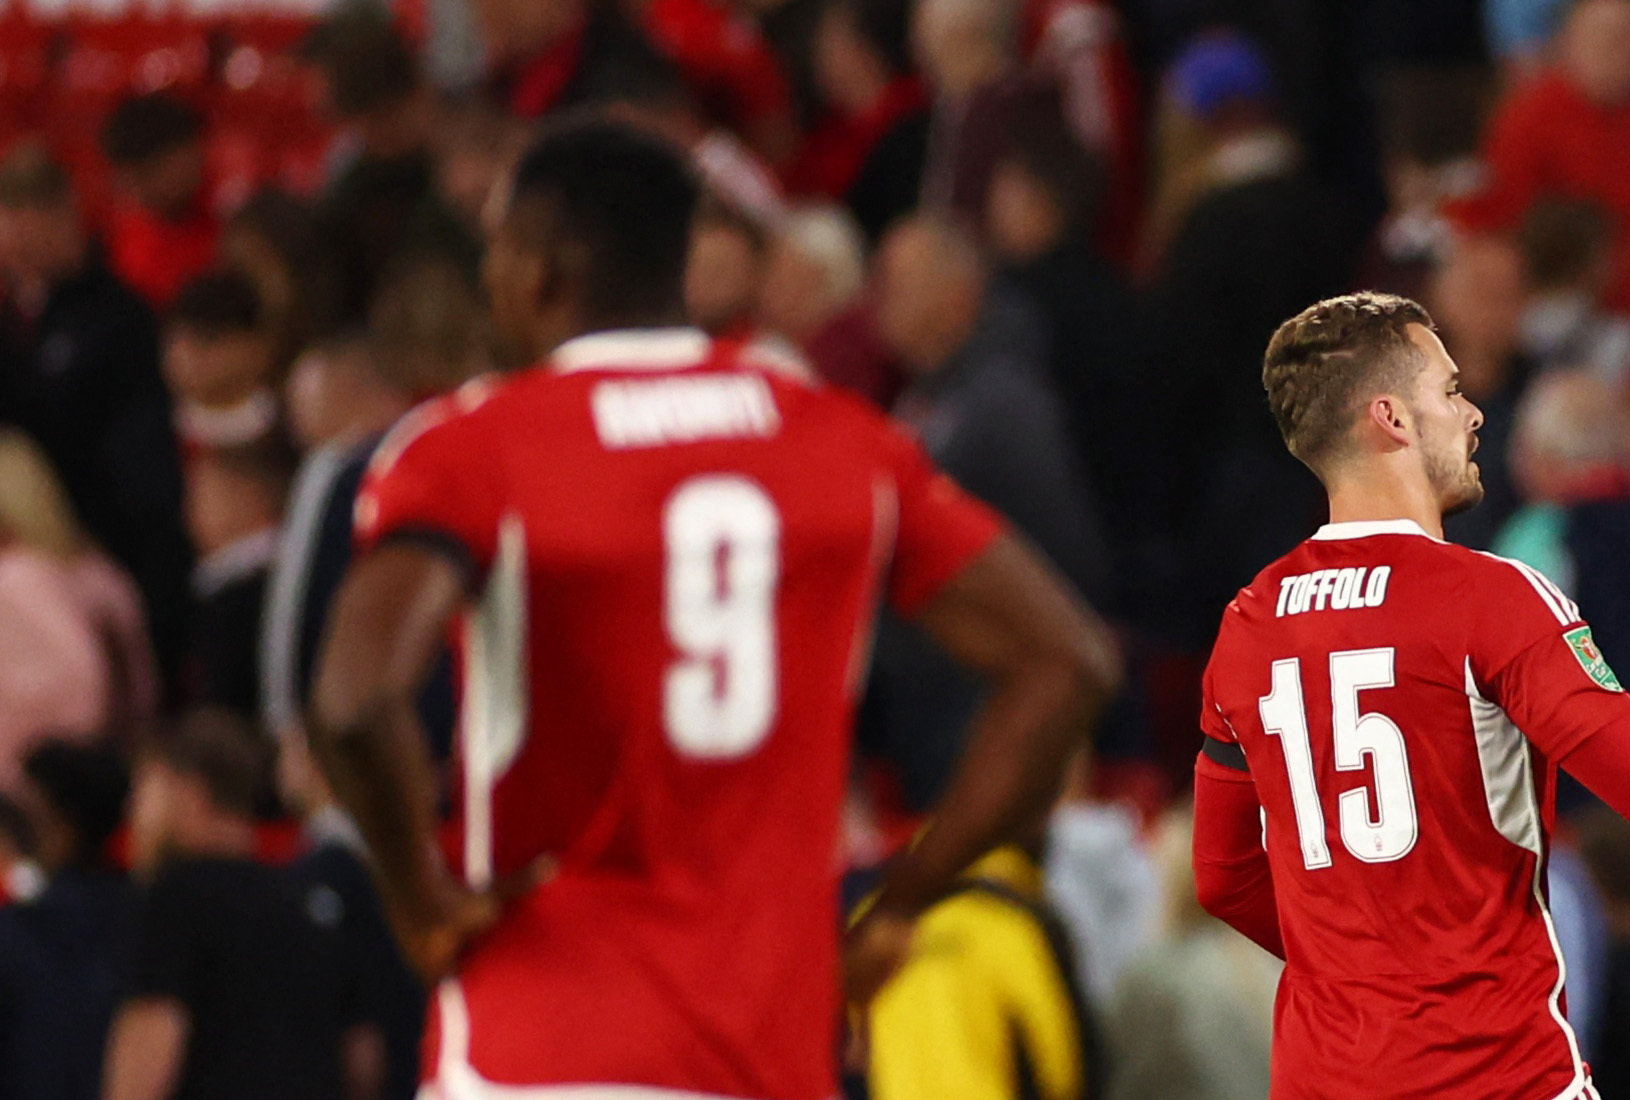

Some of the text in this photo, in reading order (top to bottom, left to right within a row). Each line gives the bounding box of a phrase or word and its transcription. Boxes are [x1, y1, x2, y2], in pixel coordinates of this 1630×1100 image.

[663, 472, 778, 764] 9
[1275, 565, 1392, 618] TOFFOLO
[1258, 647, 1418, 870] 15
